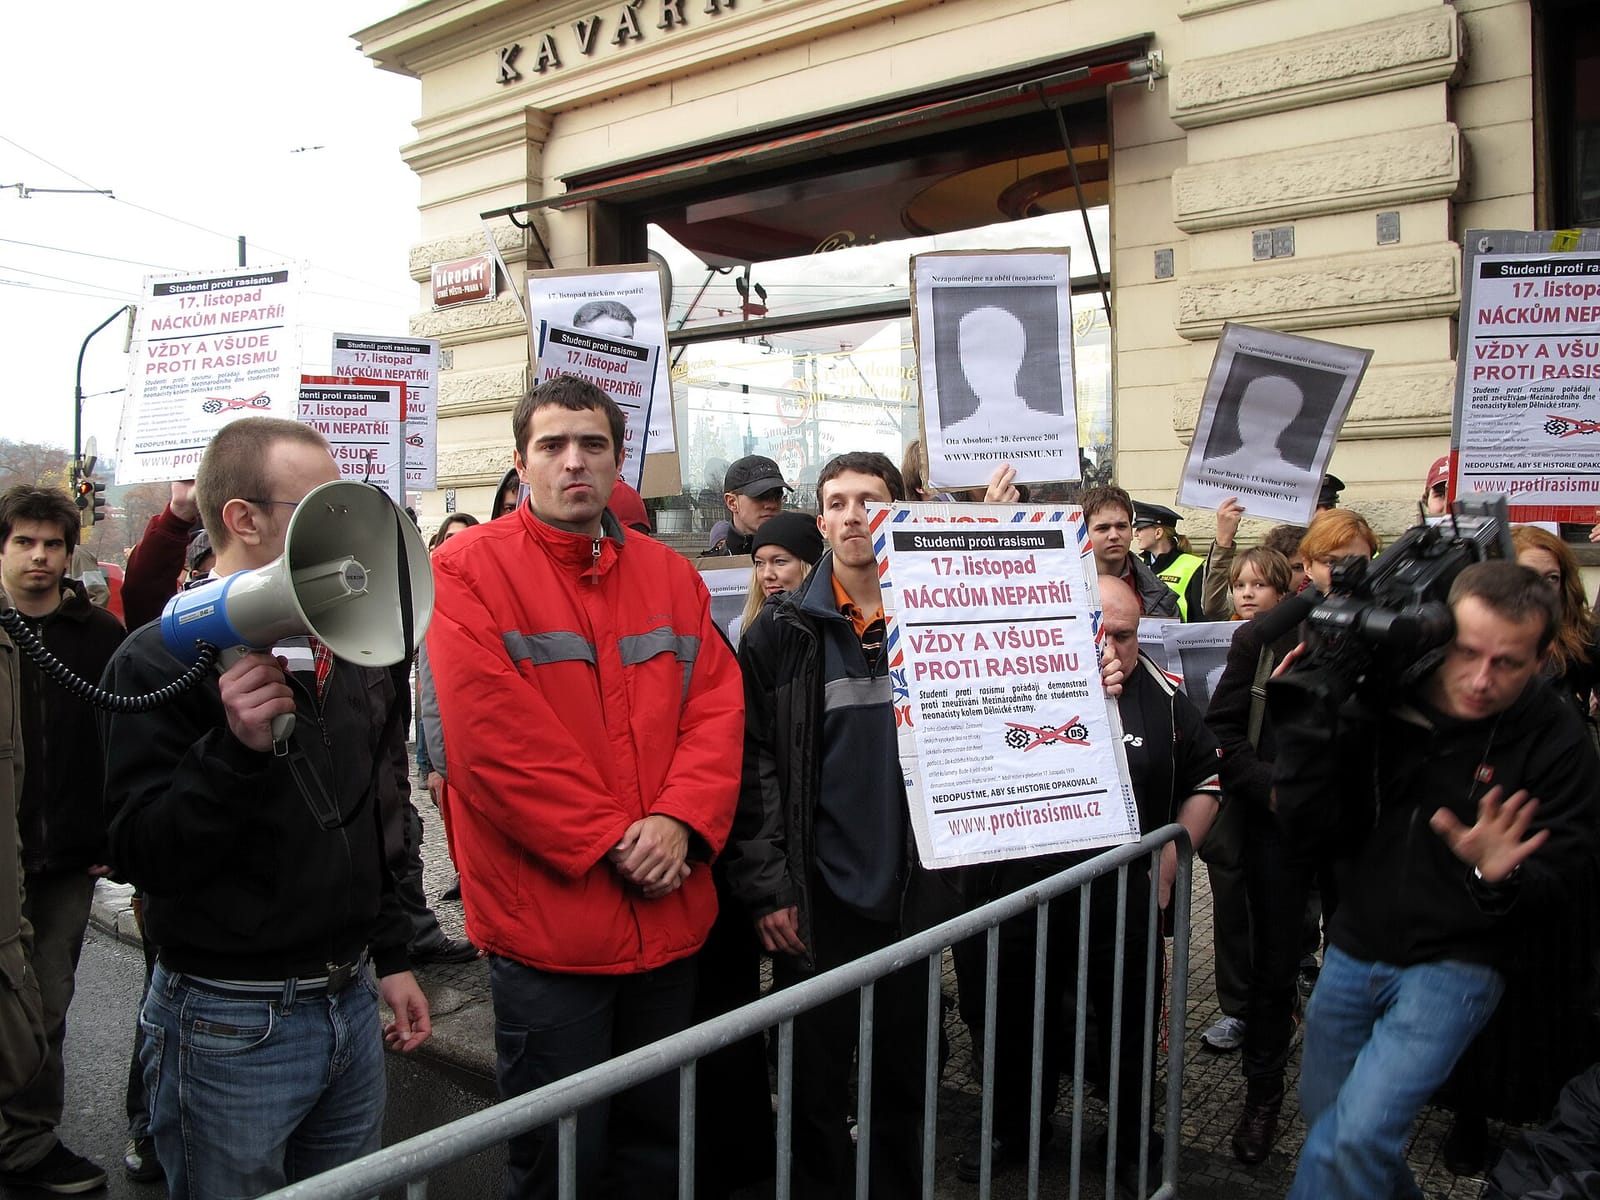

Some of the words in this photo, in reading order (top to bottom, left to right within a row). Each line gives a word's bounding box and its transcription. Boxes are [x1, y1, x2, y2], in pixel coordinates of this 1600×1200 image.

[1500, 264, 1551, 275] Studenti
[1555, 263, 1583, 275] proti
[169, 282, 209, 294] Studenti
[211, 279, 233, 291] proti
[236, 276, 274, 287] rasismu
[1513, 282, 1539, 298] 17.
[179, 296, 200, 309] 17.
[204, 289, 262, 307] listopad
[559, 290, 586, 300] listopad
[151, 312, 216, 331] NÁCKŮM
[220, 304, 285, 324] NEPATŘÍ!
[1478, 303, 1560, 325] NÁCKŮM
[148, 342, 192, 358] VŽDY
[196, 341, 208, 354] A
[214, 335, 270, 351] VŠUDE
[347, 341, 376, 350] Studenti
[376, 343, 393, 351] proti
[393, 345, 420, 353] rasismu
[561, 333, 591, 348] Studenti
[592, 341, 609, 352] proti
[609, 346, 638, 358] rasismu
[1475, 340, 1530, 359] VŽDY
[1534, 343, 1550, 358] A
[146, 359, 196, 375] PROTI
[202, 350, 277, 369] RASISMU
[354, 353, 370, 363] 17.
[372, 354, 413, 366] listopad
[567, 350, 582, 365] 17.
[584, 353, 629, 374] listopad
[336, 365, 383, 379] NÁCKŮM
[385, 367, 429, 381] NEPATŘÍ!
[1473, 365, 1535, 381] PROTI
[596, 376, 643, 398] NEPATŘÍ!
[1472, 386, 1500, 394] Studenti
[1506, 386, 1523, 394] proti
[322, 392, 342, 401] proti
[343, 393, 377, 401] rasismu
[1471, 402, 1506, 410] neonacisty
[1507, 401, 1528, 409] kolem
[1558, 401, 1581, 409] strany.
[1472, 394, 1489, 402] proti
[316, 404, 368, 418] listopad
[333, 420, 389, 435] NEPATŘÍ!
[946, 437, 960, 445] Ota
[962, 436, 993, 445] Absolon;
[1000, 435, 1011, 443] 20.
[1012, 434, 1042, 443] července
[1044, 433, 1059, 441] 2001
[141, 450, 204, 468] www.proti
[331, 446, 378, 460] VŠUDE
[944, 449, 1064, 462] WWW.PROTIRASISMU.NET
[339, 463, 386, 475] SISMU
[1207, 468, 1224, 476] Tibor
[1282, 481, 1297, 489] 1995
[1198, 478, 1299, 503] WWW.PROTIRASISMU.NET
[914, 535, 965, 549] Studenti
[968, 535, 995, 550] proti
[999, 535, 1045, 547] rasismu
[931, 557, 961, 576] 17.
[963, 554, 1036, 579] listopad
[903, 582, 988, 609] NÁCKŮM
[992, 580, 1072, 606] NEPATŘÍ!
[908, 629, 966, 654] VŽDY
[973, 632, 990, 651] A
[993, 626, 1065, 650] VŠUDE
[914, 659, 980, 682] PROTI
[985, 653, 1080, 677] RASISMU
[919, 688, 949, 700] Studenti
[955, 686, 972, 699] proti
[979, 686, 1005, 696] rasismu
[1047, 678, 1088, 690] demonstraci
[920, 700, 939, 712] proti
[1035, 691, 1048, 701] dne
[1050, 689, 1089, 700] studentstva
[922, 707, 961, 721] neonacisty
[961, 705, 983, 717] kolem
[983, 701, 1012, 715] Dělnické
[1013, 703, 1037, 714] strany.
[1070, 728, 1083, 738] DS
[932, 790, 989, 804] NEDOPUSŤME,
[991, 787, 1006, 797] ABY
[1006, 786, 1016, 795] SE
[1017, 782, 1051, 794] HISTORIE
[1052, 777, 1098, 790] OPAKOVALA!
[948, 801, 1101, 836] www.protirasismu.cz
